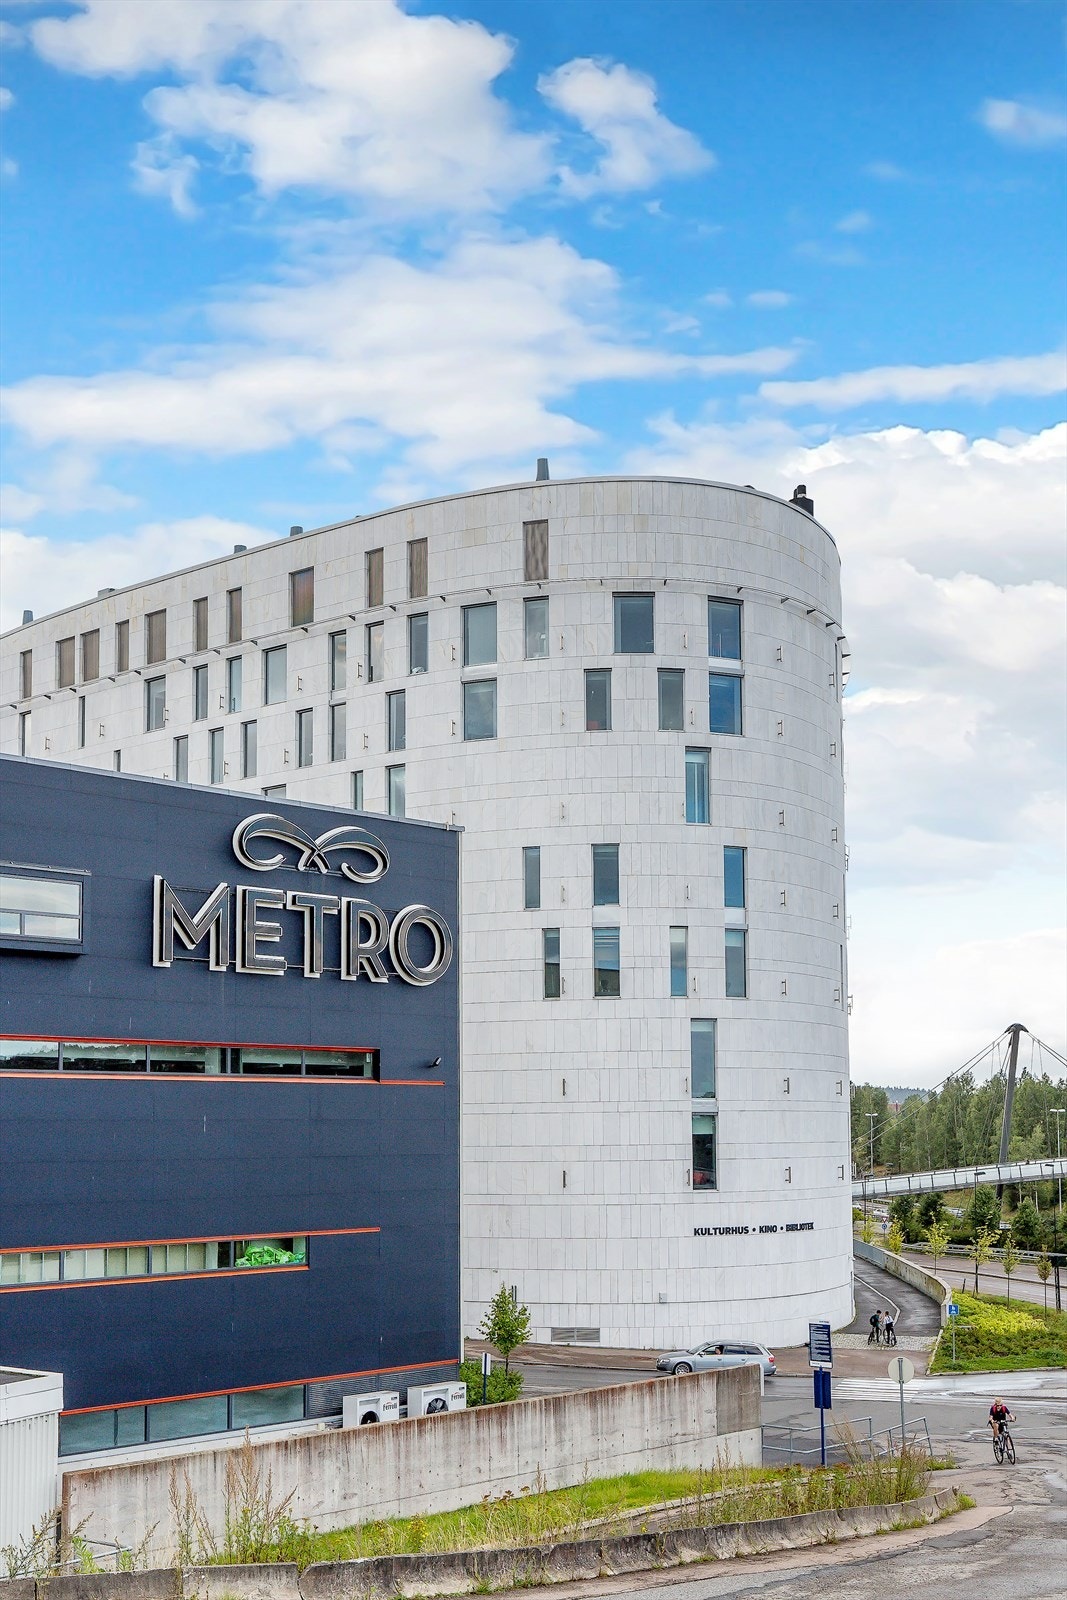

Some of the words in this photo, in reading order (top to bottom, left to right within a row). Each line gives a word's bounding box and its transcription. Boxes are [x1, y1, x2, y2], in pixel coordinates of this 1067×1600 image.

[152, 875, 453, 986] METRO
[694, 1226, 749, 1236] KULTURHUS
[759, 1224, 777, 1234] KINO
